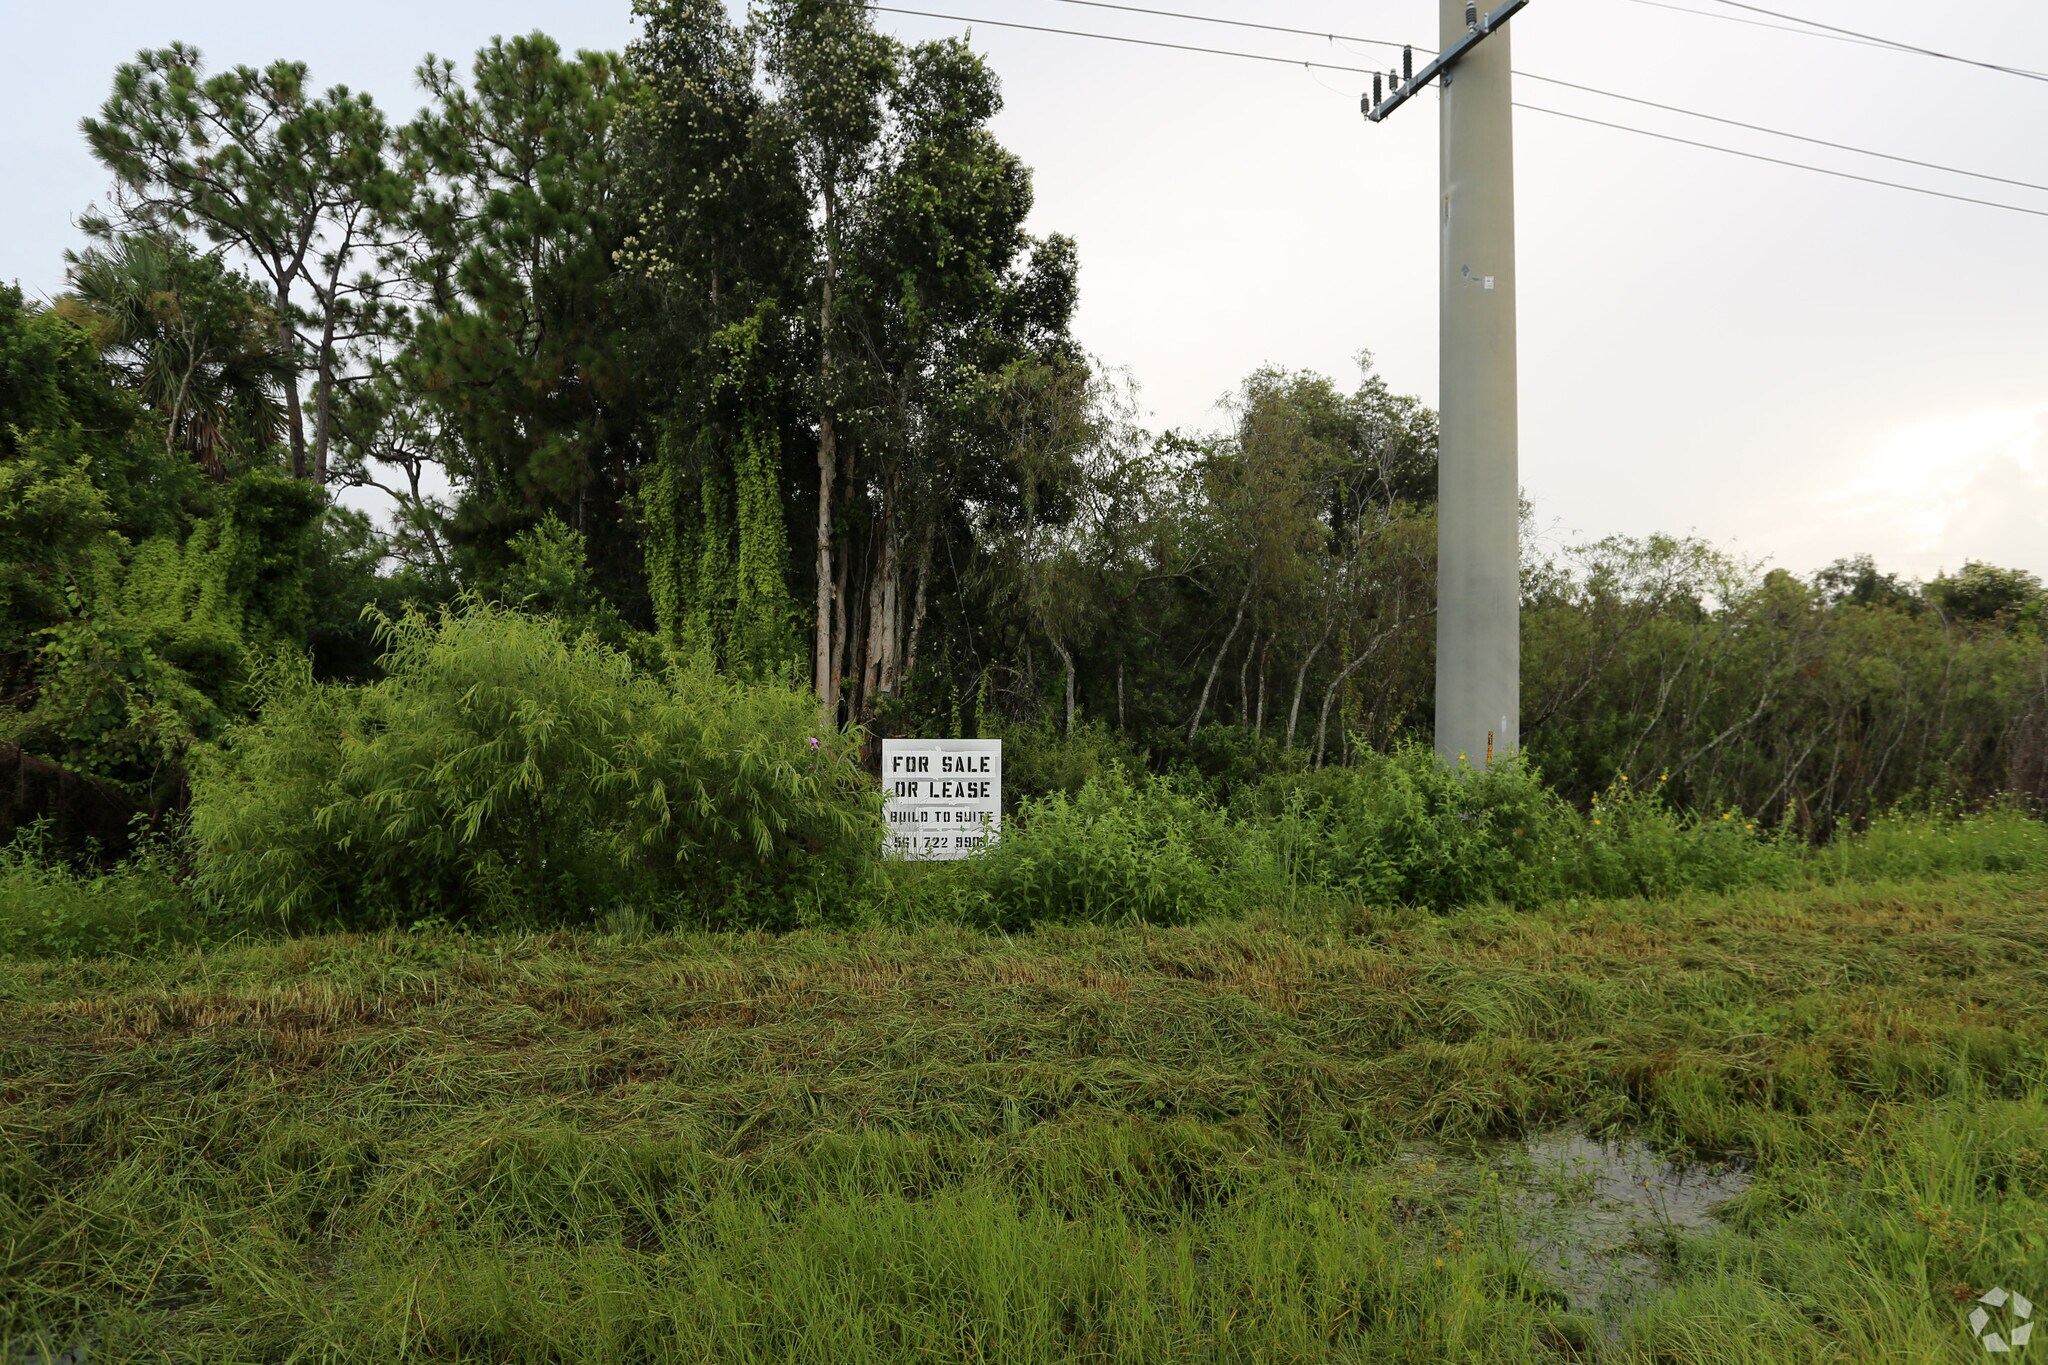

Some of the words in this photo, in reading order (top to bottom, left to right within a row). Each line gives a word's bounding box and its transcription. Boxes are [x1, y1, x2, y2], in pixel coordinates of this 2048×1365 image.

[893, 756, 929, 772] FOR
[942, 756, 990, 772] SALE
[895, 781, 918, 798] OR
[929, 781, 990, 798] LEASE
[890, 811, 928, 823] BUILD
[935, 811, 951, 823] TO
[924, 837, 948, 848] 722
